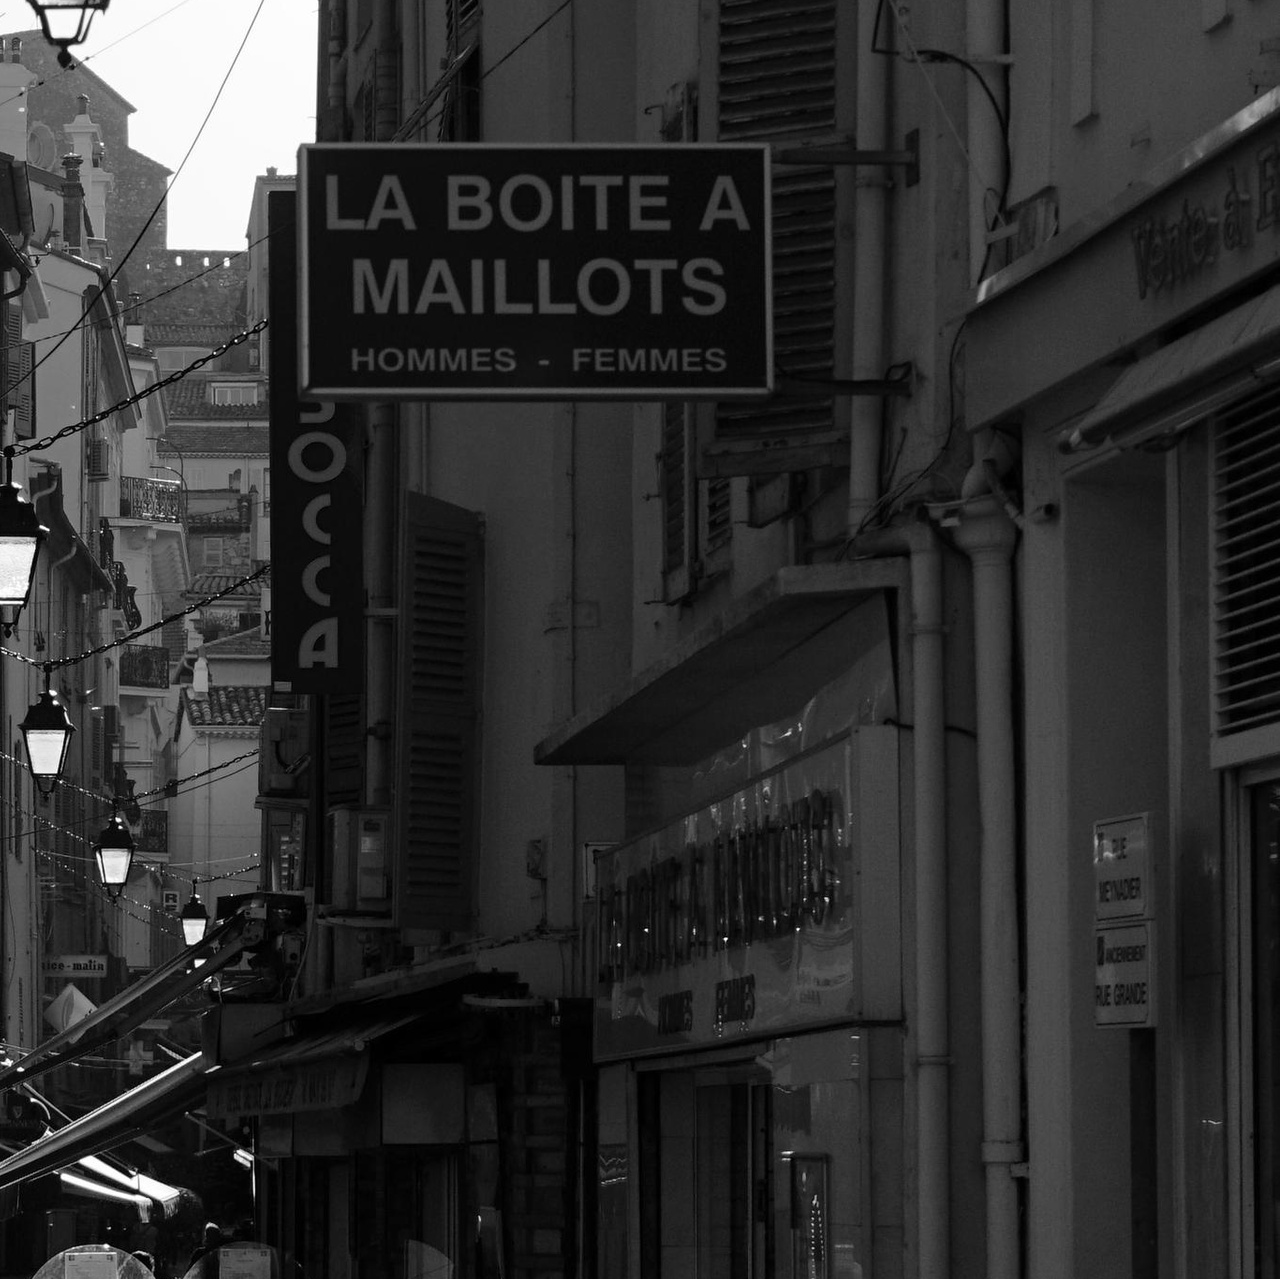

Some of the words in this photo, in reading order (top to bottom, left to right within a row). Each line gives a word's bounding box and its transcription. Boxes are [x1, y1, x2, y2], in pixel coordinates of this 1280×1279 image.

[325, 174, 417, 231] LA
[447, 174, 671, 232] BOITE
[699, 174, 751, 231] A
[352, 257, 728, 317] MAILLOTS
[351, 347, 517, 372] HOMMES
[572, 347, 728, 372] FEMMES
[1096, 985, 1111, 1006] RUE
[1114, 982, 1147, 1006] GRANDE
